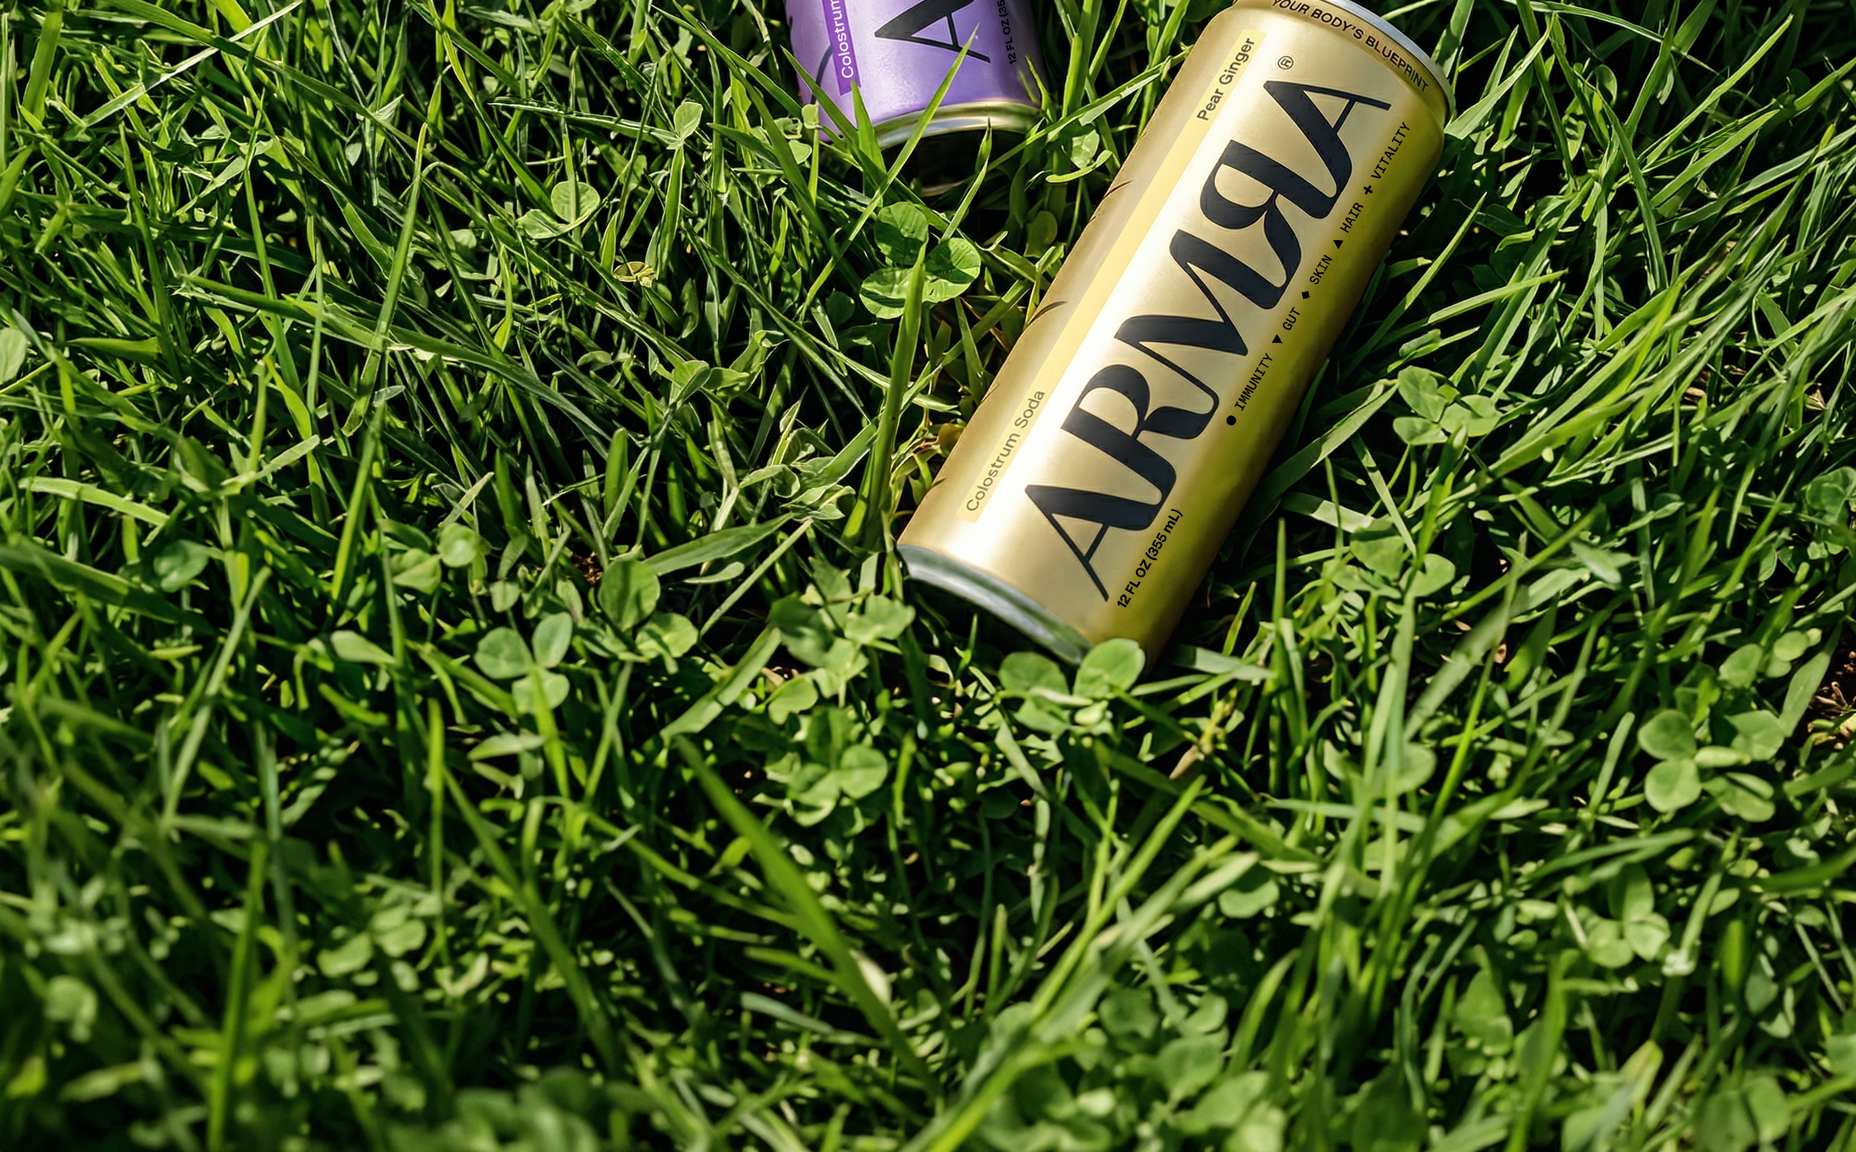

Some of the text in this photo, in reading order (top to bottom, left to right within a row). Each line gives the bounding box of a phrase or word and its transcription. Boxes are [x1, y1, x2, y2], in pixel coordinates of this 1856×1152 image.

[1001, 19, 1011, 35] OZ
[1005, 37, 1014, 51] FL
[1007, 52, 1017, 65] 12
[1310, 8, 1364, 40] BODY'S
[1366, 36, 1429, 93] BLUEPRINT
[1197, 37, 1255, 121] Pear Ginger
[1234, 121, 1411, 411] IMMUNITY GUT SKIN HAIR VITALITY
[966, 390, 1046, 513] Colostrum Soda
[1117, 508, 1183, 608] 12 FL OZ (355 mL)
